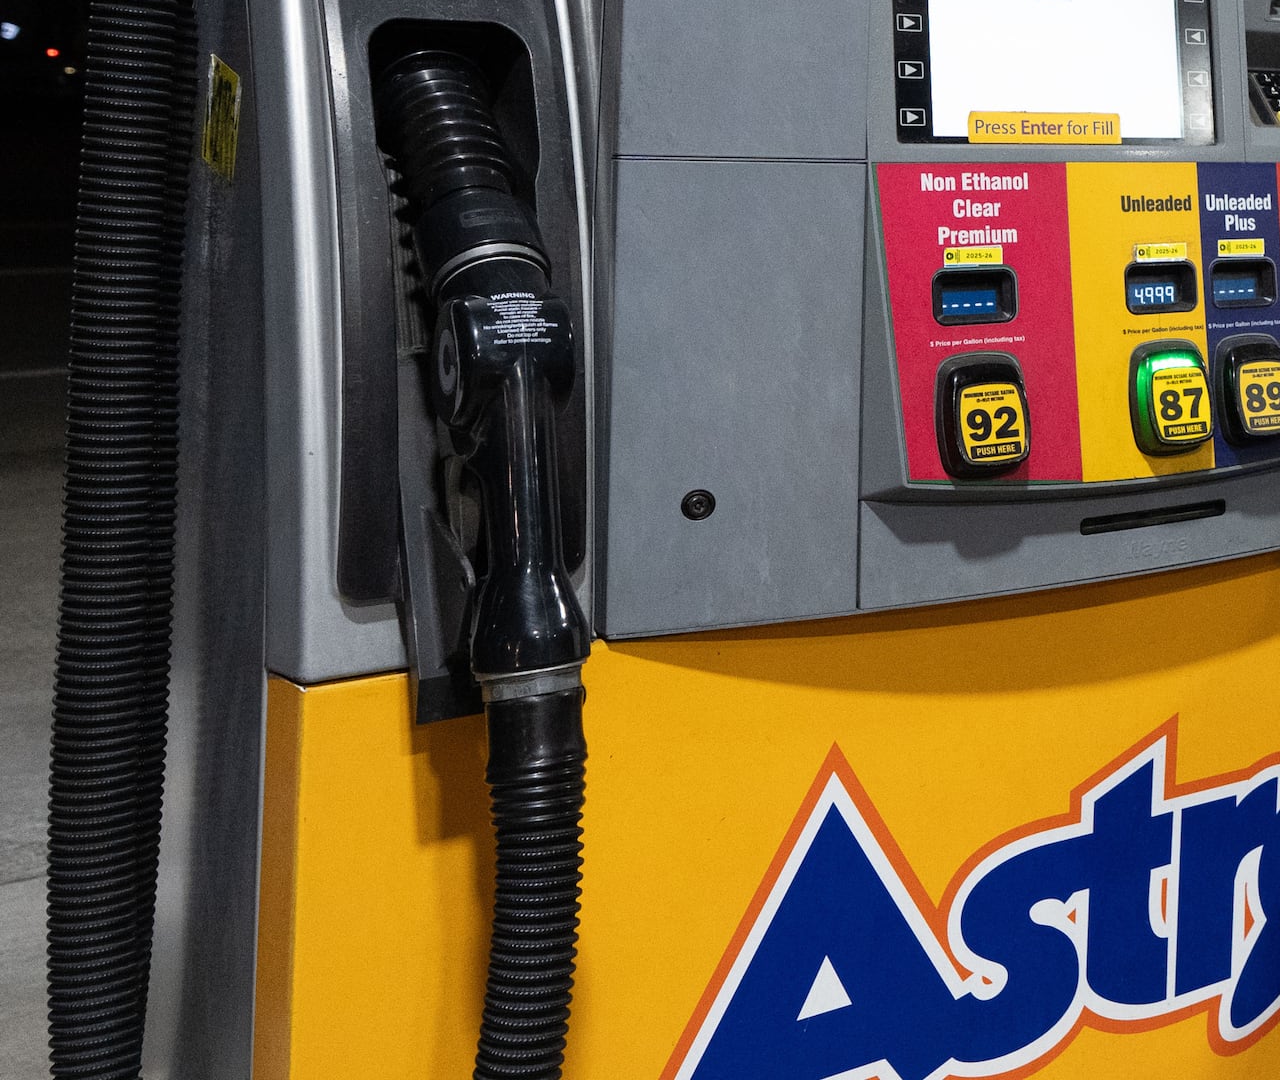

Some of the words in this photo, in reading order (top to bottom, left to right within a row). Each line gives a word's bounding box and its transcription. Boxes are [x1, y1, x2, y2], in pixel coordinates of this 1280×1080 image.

[975, 119, 1017, 136] Press
[1021, 119, 1064, 136] Enter
[1067, 119, 1090, 136] for
[1093, 120, 1114, 136] Fill
[920, 172, 956, 192] Non
[961, 172, 1029, 191] Ethanol
[953, 198, 1001, 218] Clear
[1120, 195, 1192, 212] Unleaded
[1205, 193, 1271, 211] Unleaded
[1224, 214, 1256, 231] Plus
[938, 225, 1018, 245] Premium
[490, 292, 535, 301] WARNING
[1134, 286, 1174, 304] 4.999
[984, 337, 1013, 345] (including
[1160, 387, 1203, 421] 87
[966, 406, 1020, 442] 92
[1168, 425, 1185, 435] PUSH
[1186, 424, 1203, 433] HERE
[1254, 417, 1270, 426] PUSH
[976, 446, 997, 456] PUSH
[997, 444, 1016, 453] HERE
